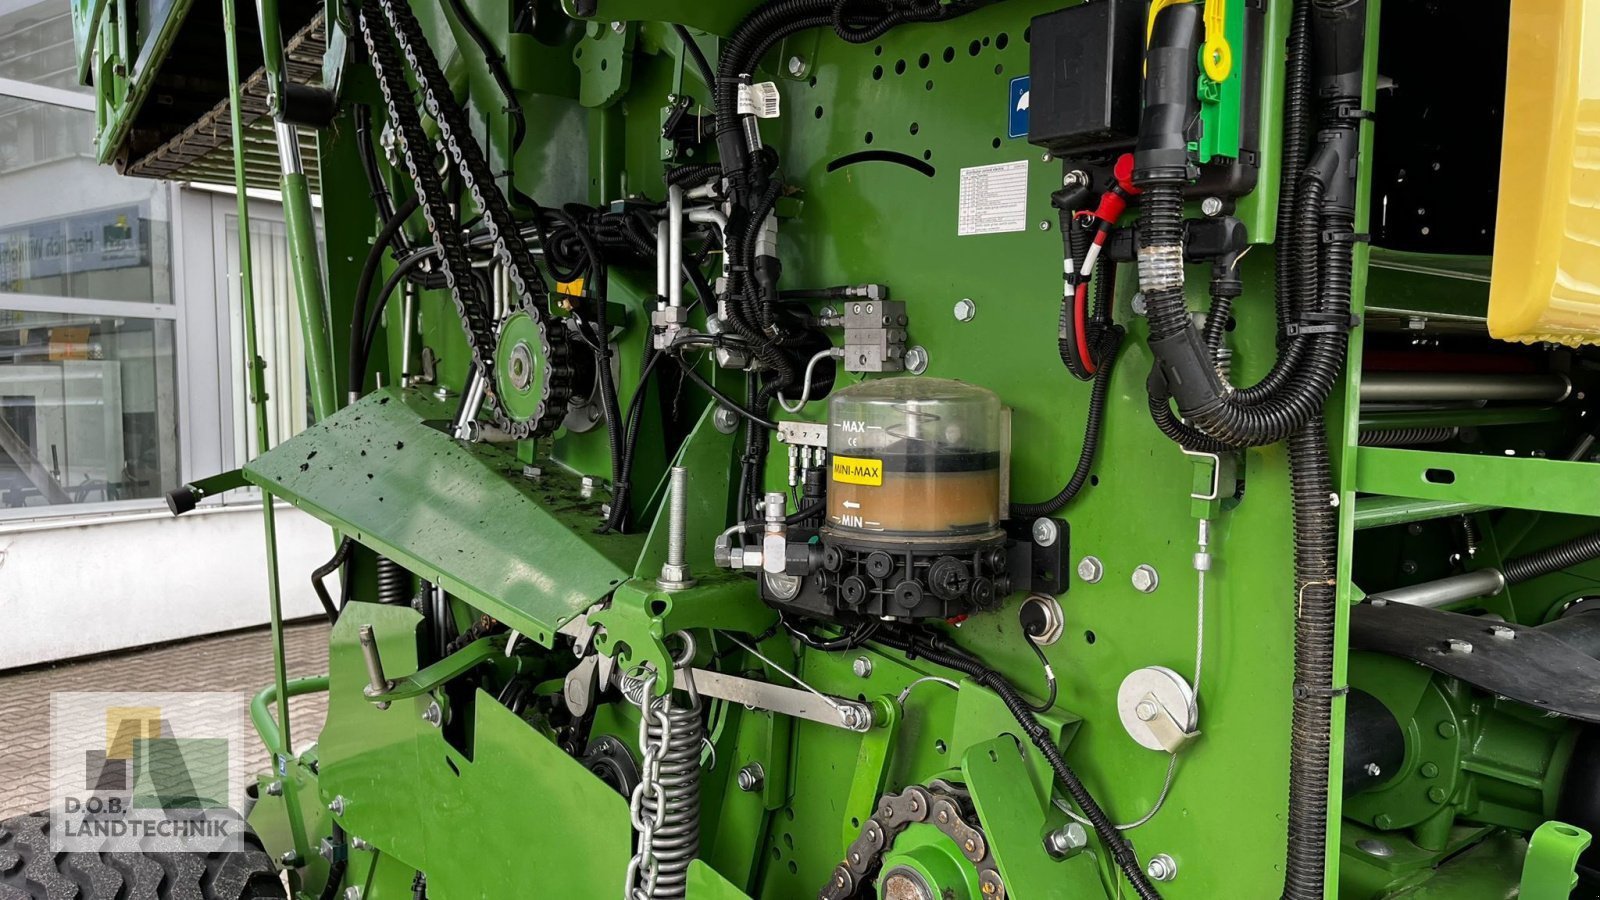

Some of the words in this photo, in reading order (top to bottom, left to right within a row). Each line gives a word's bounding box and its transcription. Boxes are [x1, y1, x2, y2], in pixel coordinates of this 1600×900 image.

[842, 420, 865, 432] MAX
[834, 463, 879, 477] MINI-MAX
[841, 514, 863, 528] MIN
